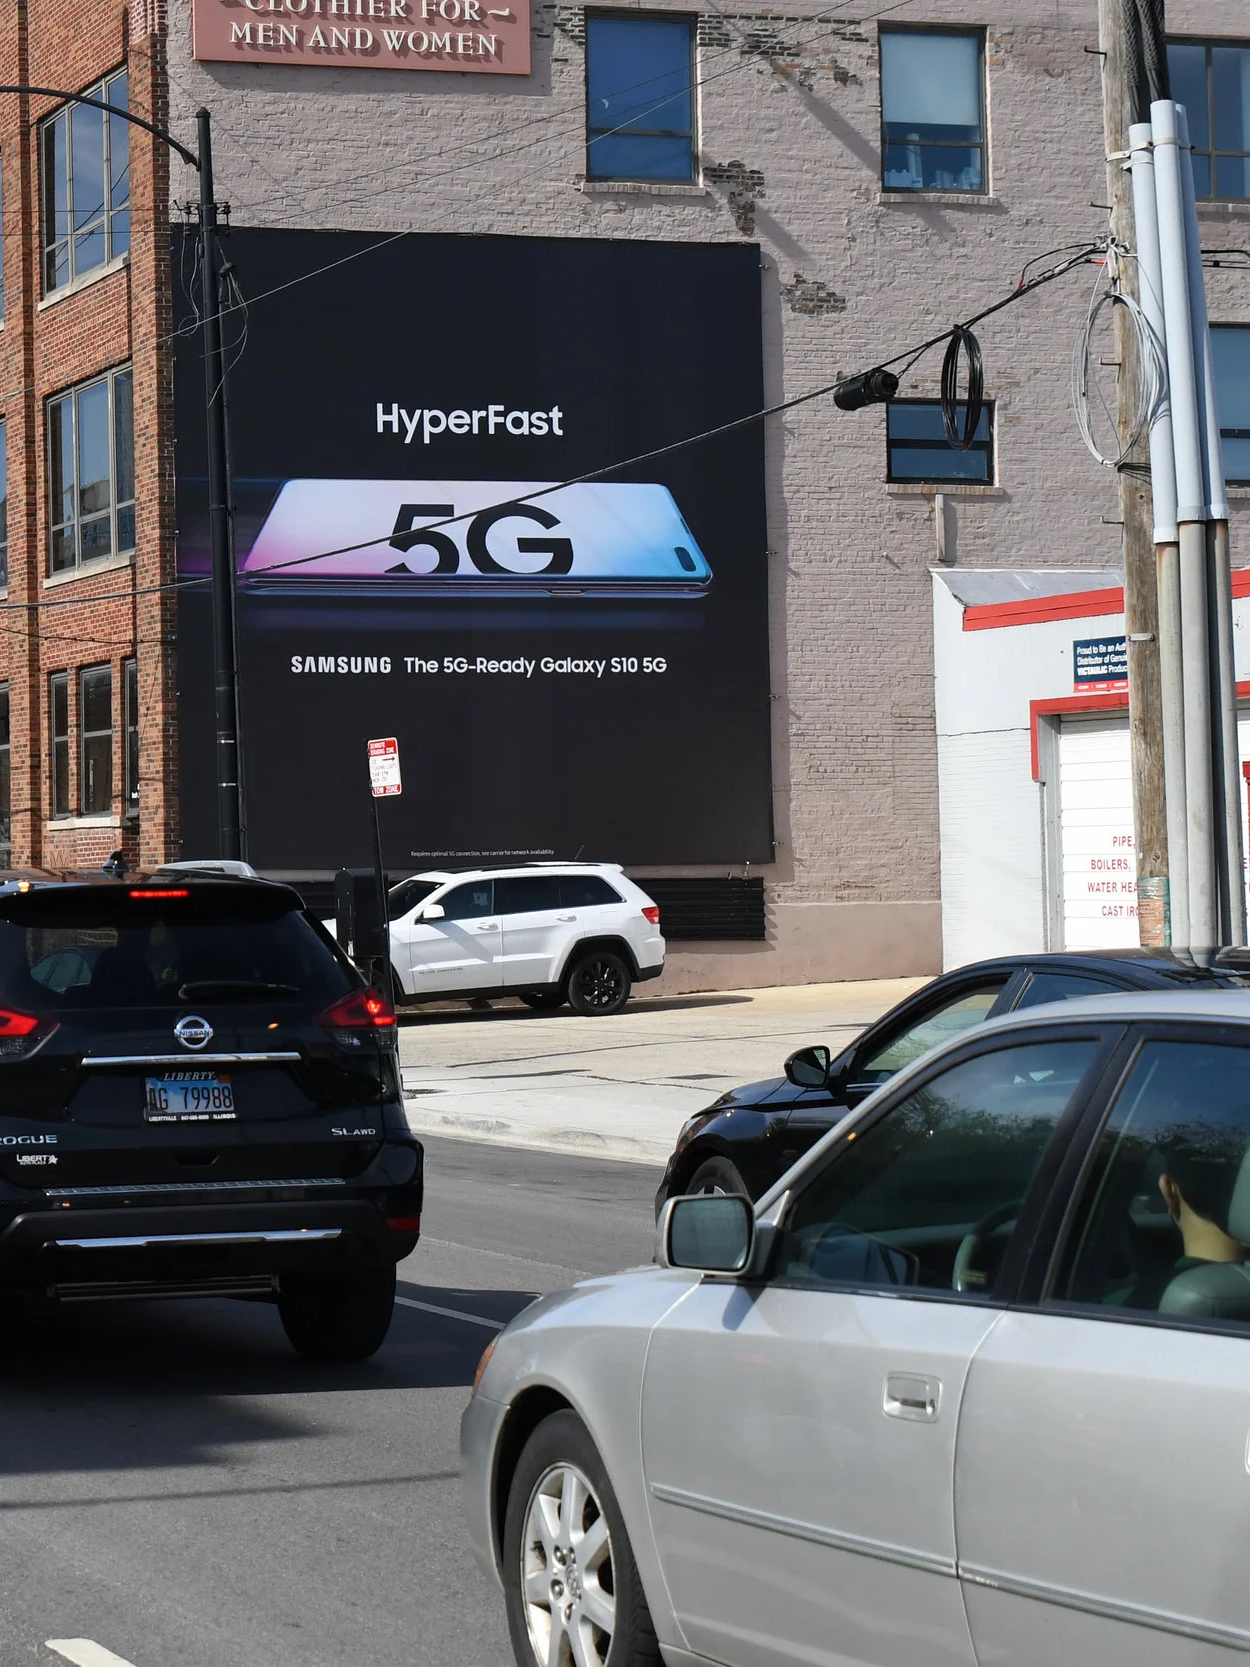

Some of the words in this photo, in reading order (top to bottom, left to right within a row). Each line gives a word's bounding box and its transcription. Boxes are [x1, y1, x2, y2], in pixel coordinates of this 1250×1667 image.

[247, 0, 407, 18] CLOTHIER
[419, 0, 481, 21] FOR
[230, 22, 298, 47] MEN
[307, 25, 373, 49] AND
[381, 29, 498, 56] WOMEN
[376, 403, 564, 444] HyperFast
[384, 502, 574, 575] 5G
[1077, 646, 1092, 655] Proud
[1093, 645, 1098, 653] to
[1099, 644, 1106, 653] Be
[1077, 656, 1103, 665] Distributor
[1104, 654, 1109, 663] of
[291, 656, 392, 674] SAMSUNG
[404, 657, 439, 673] The
[443, 657, 535, 678] 5G-Ready
[540, 657, 606, 678] Galaxy
[611, 658, 638, 674] S10
[643, 658, 667, 674] 5G
[1077, 665, 1108, 676] VICTAULIC
[411, 850, 430, 858] Requires
[431, 850, 448, 858] optimal
[1091, 859, 1131, 872] BOILERS,
[1088, 882, 1117, 893] WATER
[1102, 906, 1123, 917] CAST
[164, 1072, 215, 1081] LIBERTY
[148, 1087, 168, 1110] AG
[180, 1086, 232, 1110] 79988
[331, 1128, 352, 1136] SL
[353, 1128, 376, 1136] AWD
